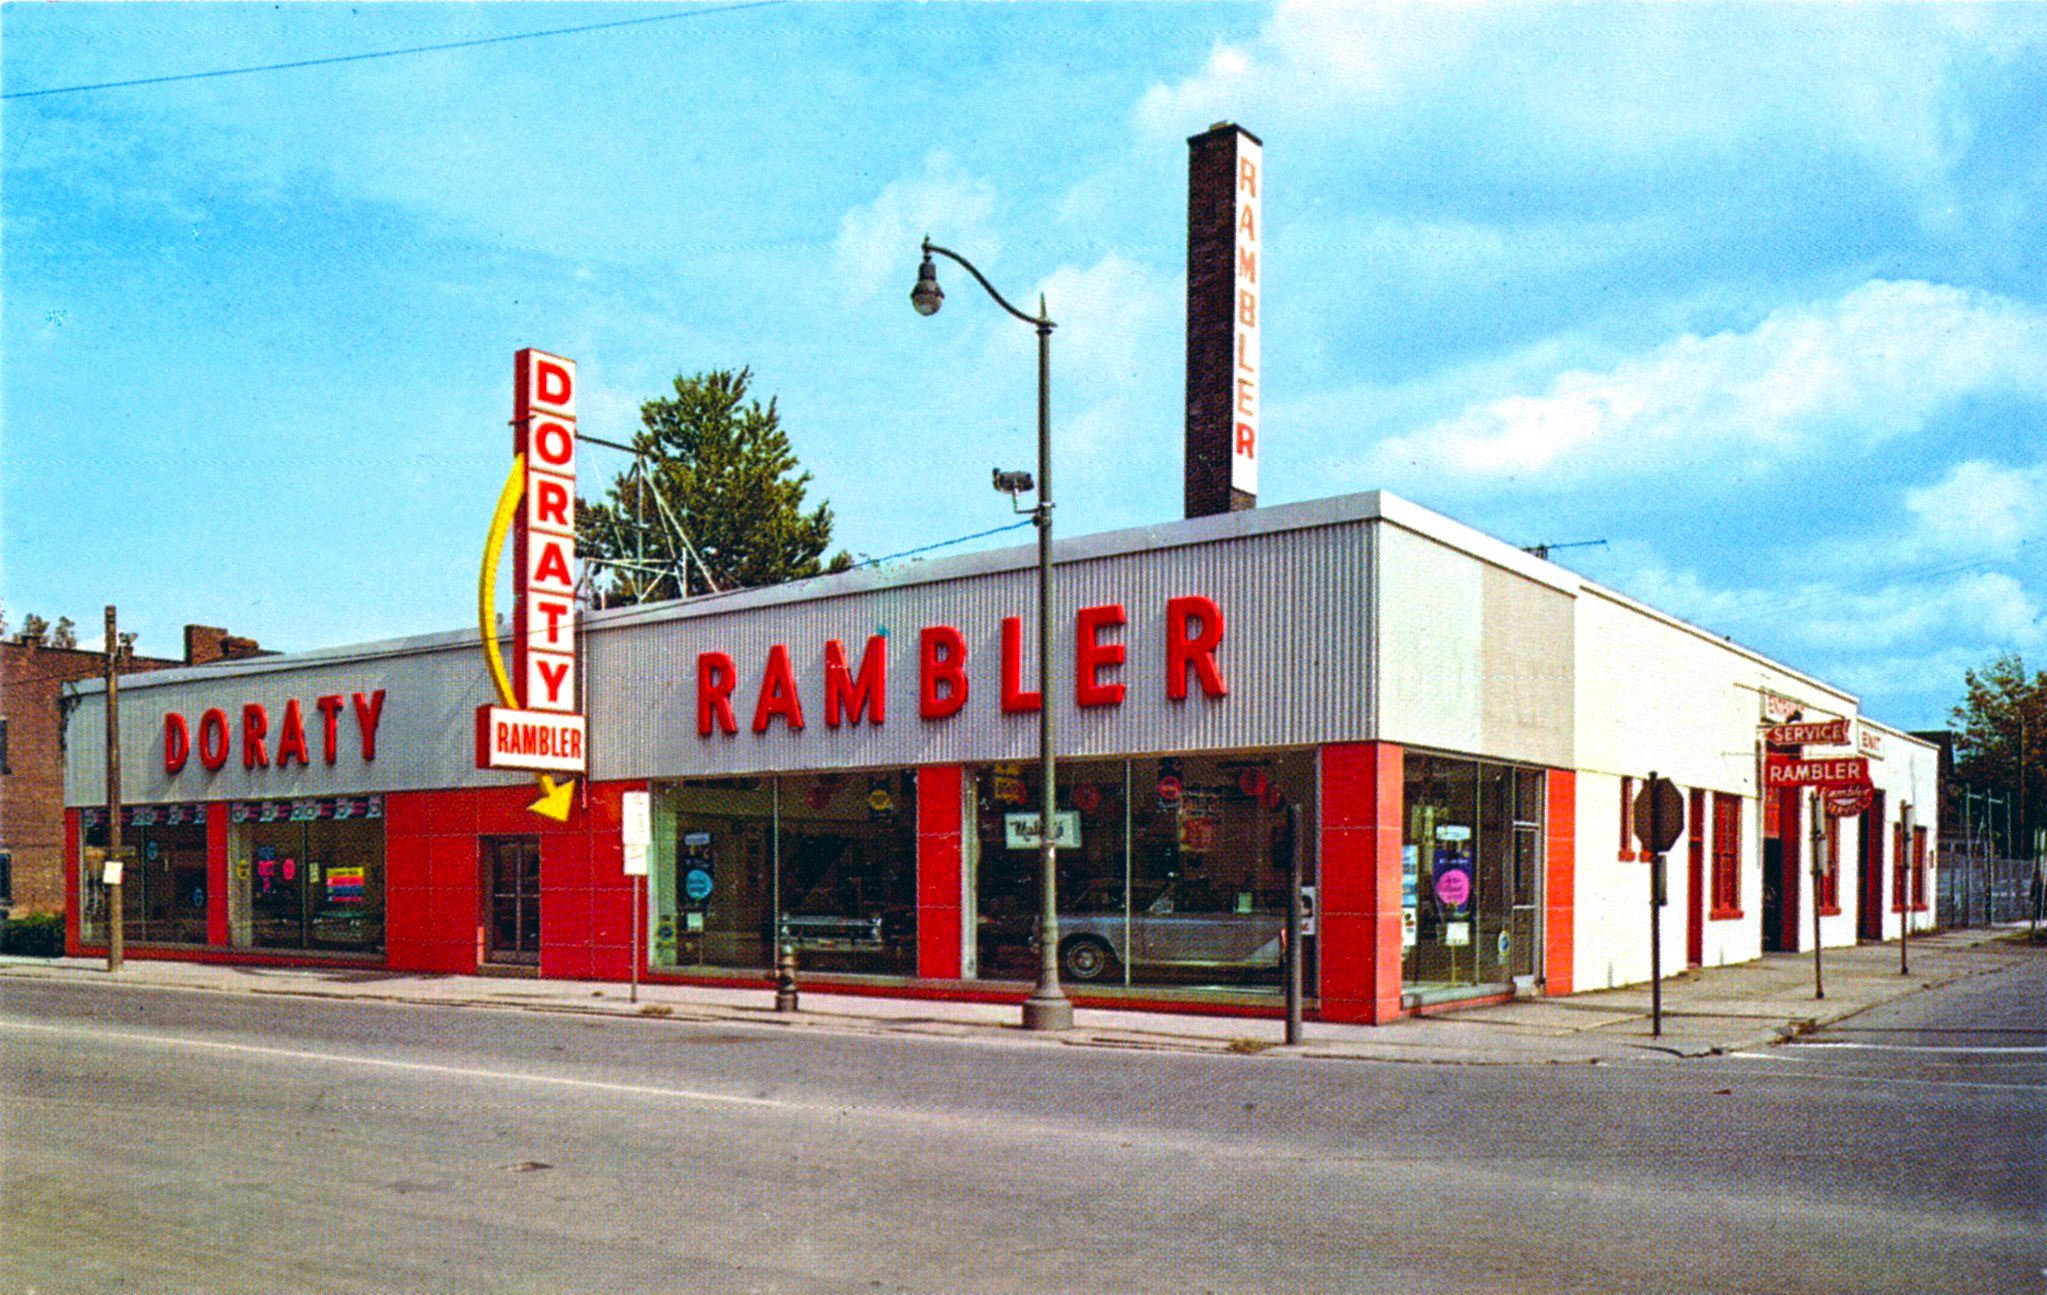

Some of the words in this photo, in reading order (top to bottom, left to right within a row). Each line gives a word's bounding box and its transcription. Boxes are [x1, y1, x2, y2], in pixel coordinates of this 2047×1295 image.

[1236, 157, 1257, 460] RAMBLER
[534, 360, 573, 702] DORATY
[697, 595, 1228, 735] RAMBLER
[164, 689, 387, 773] DORATY
[497, 723, 582, 759] RAMBLER
[1769, 763, 1861, 783] RAMBLER
[1774, 724, 1841, 742] SERVICE
